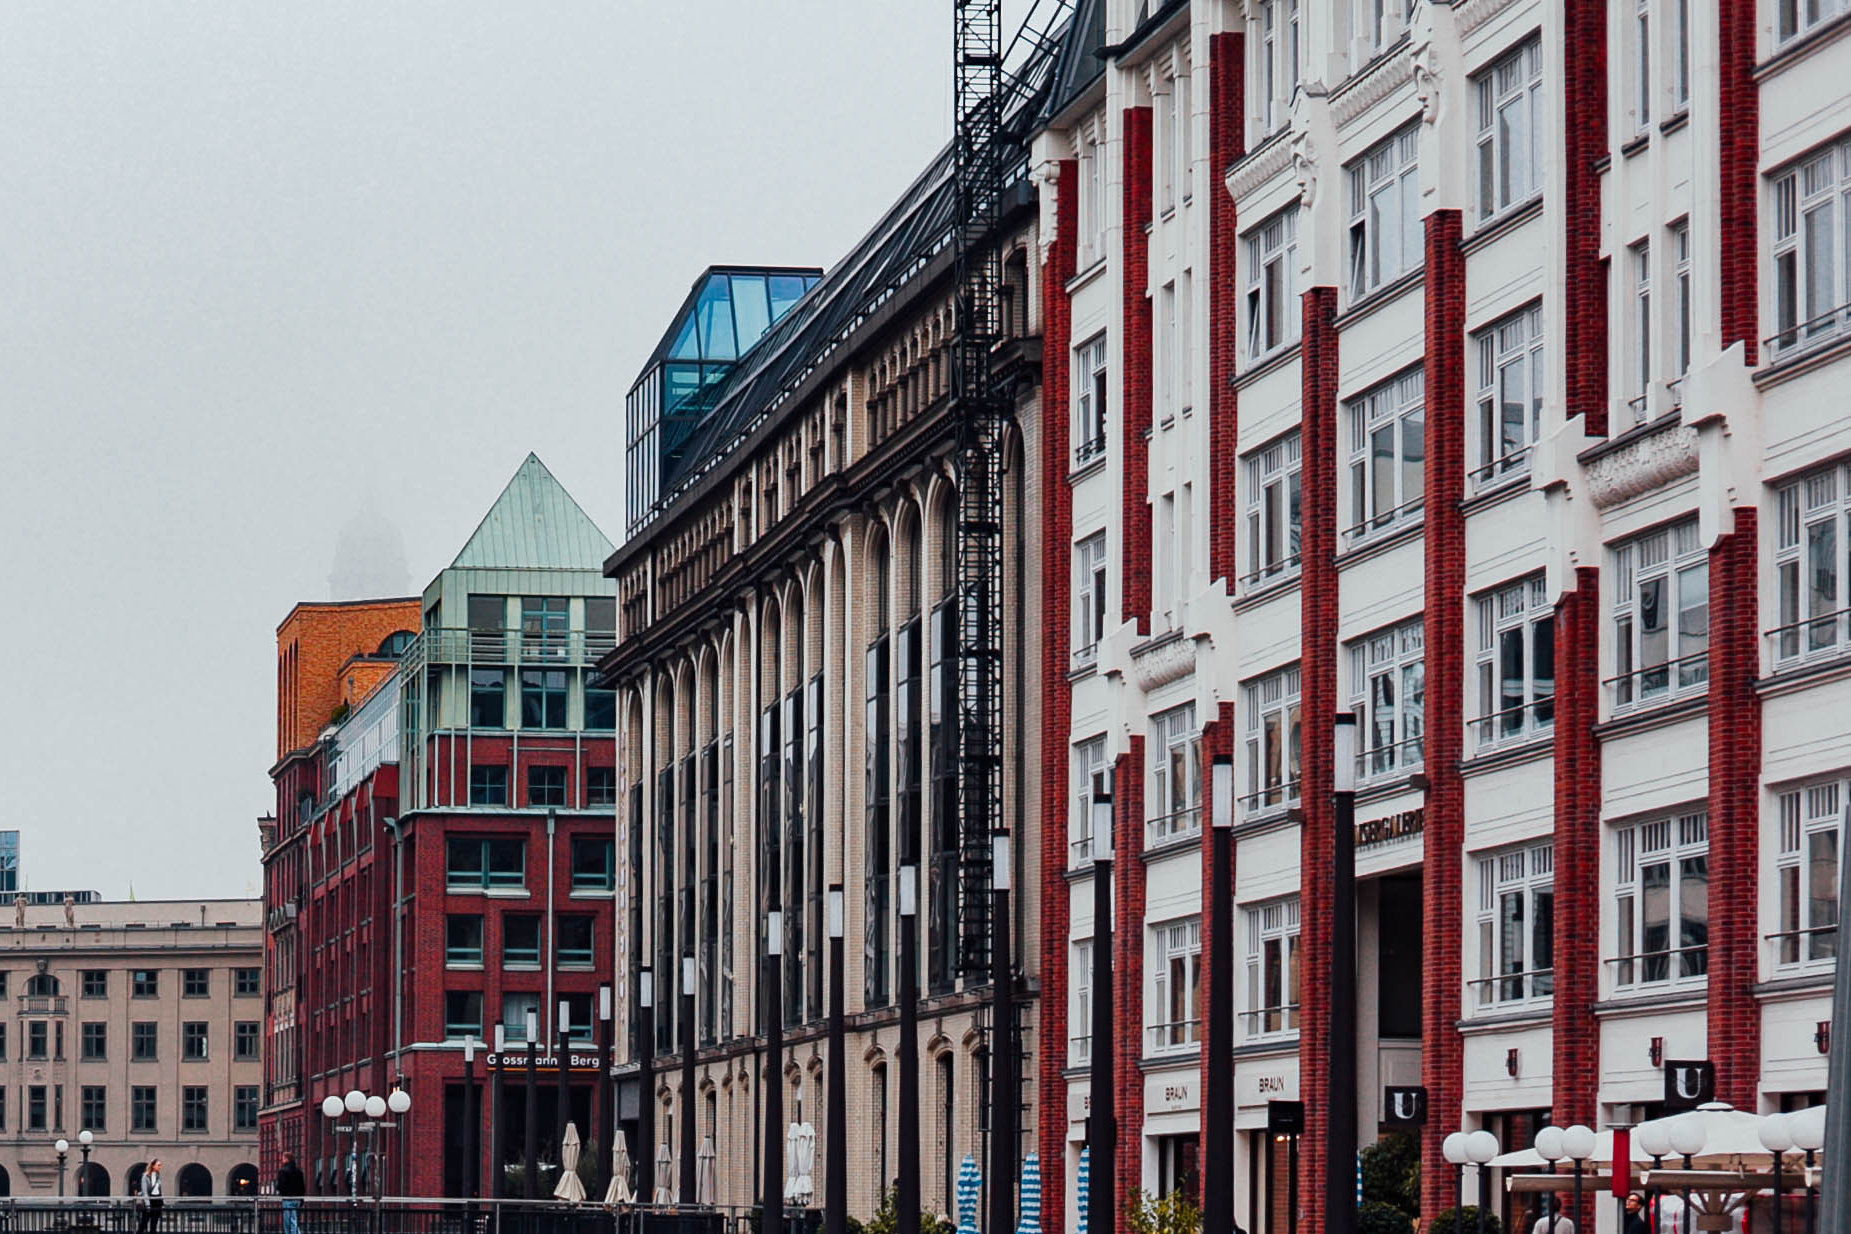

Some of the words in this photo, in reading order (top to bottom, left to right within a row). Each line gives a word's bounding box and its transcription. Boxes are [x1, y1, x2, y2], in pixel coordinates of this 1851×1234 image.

[487, 1054, 558, 1065] Gossann
[570, 1055, 600, 1068] Berg
[1259, 1076, 1284, 1092] BRAUN
[1674, 1067, 1703, 1099] U
[1165, 1086, 1188, 1101] BRAUN
[1393, 1092, 1418, 1119] U
